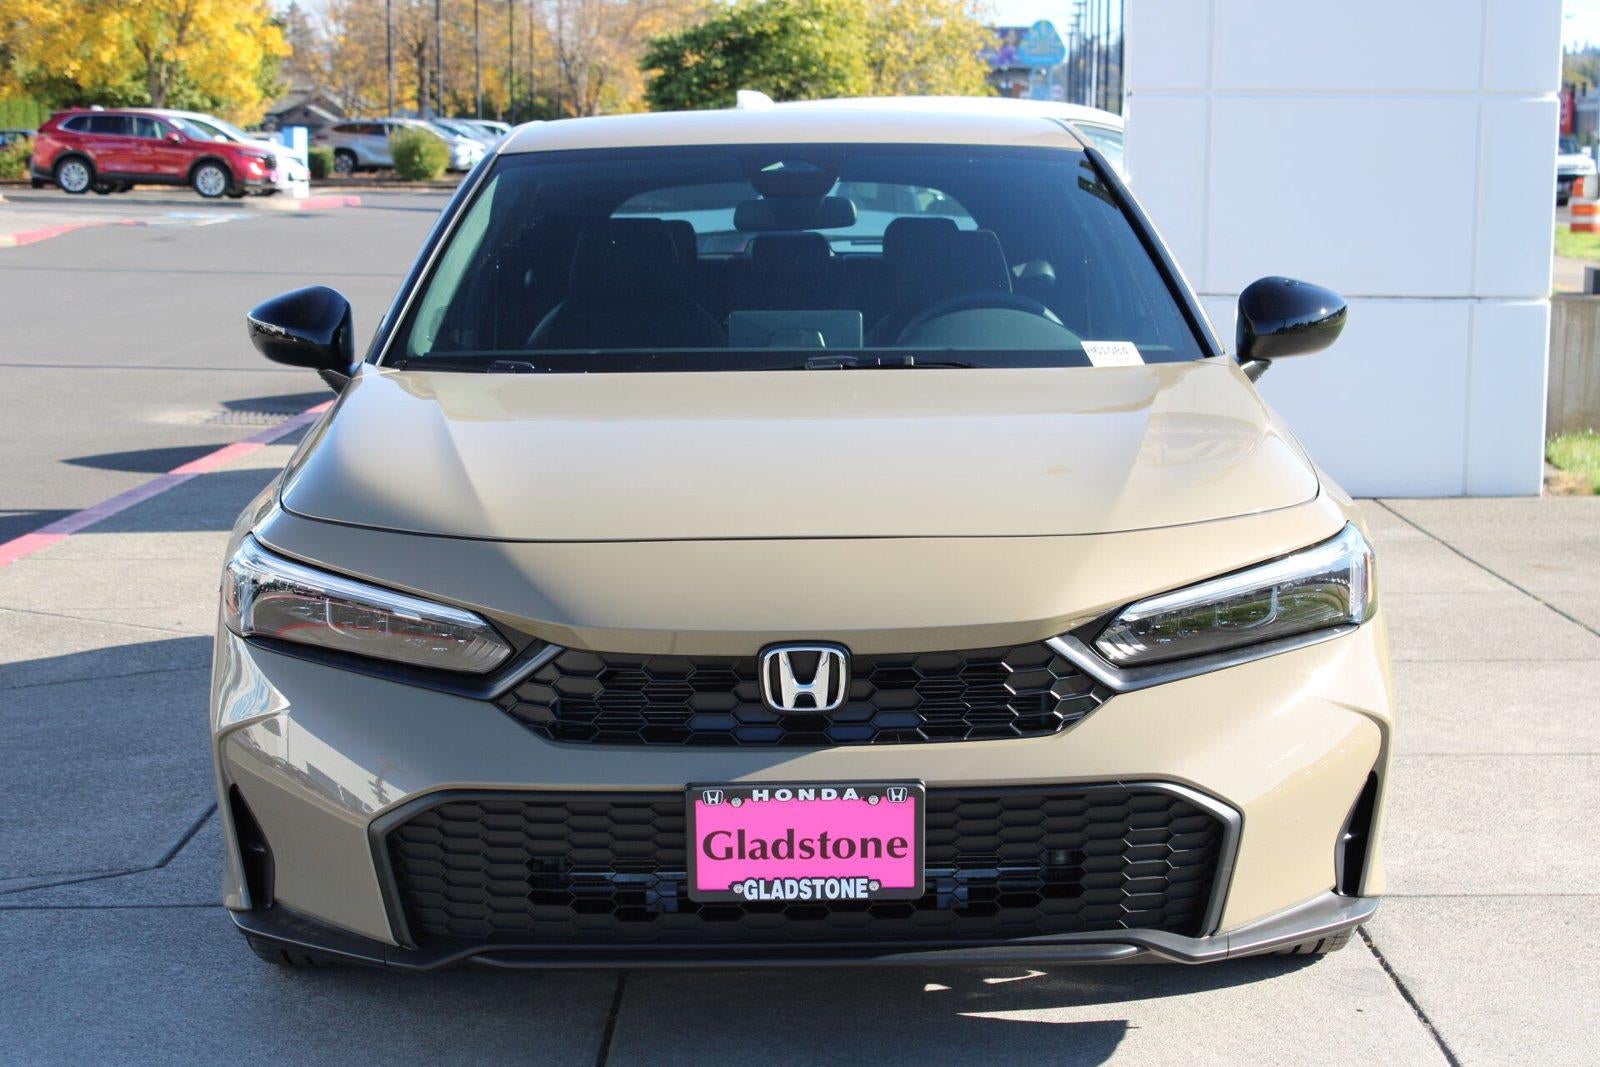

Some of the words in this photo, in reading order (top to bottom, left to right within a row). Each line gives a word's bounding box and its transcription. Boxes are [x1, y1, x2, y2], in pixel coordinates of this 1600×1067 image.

[753, 788, 860, 802] HONDA
[702, 829, 908, 860] Gladstone
[744, 878, 869, 901] GLADSTONE
